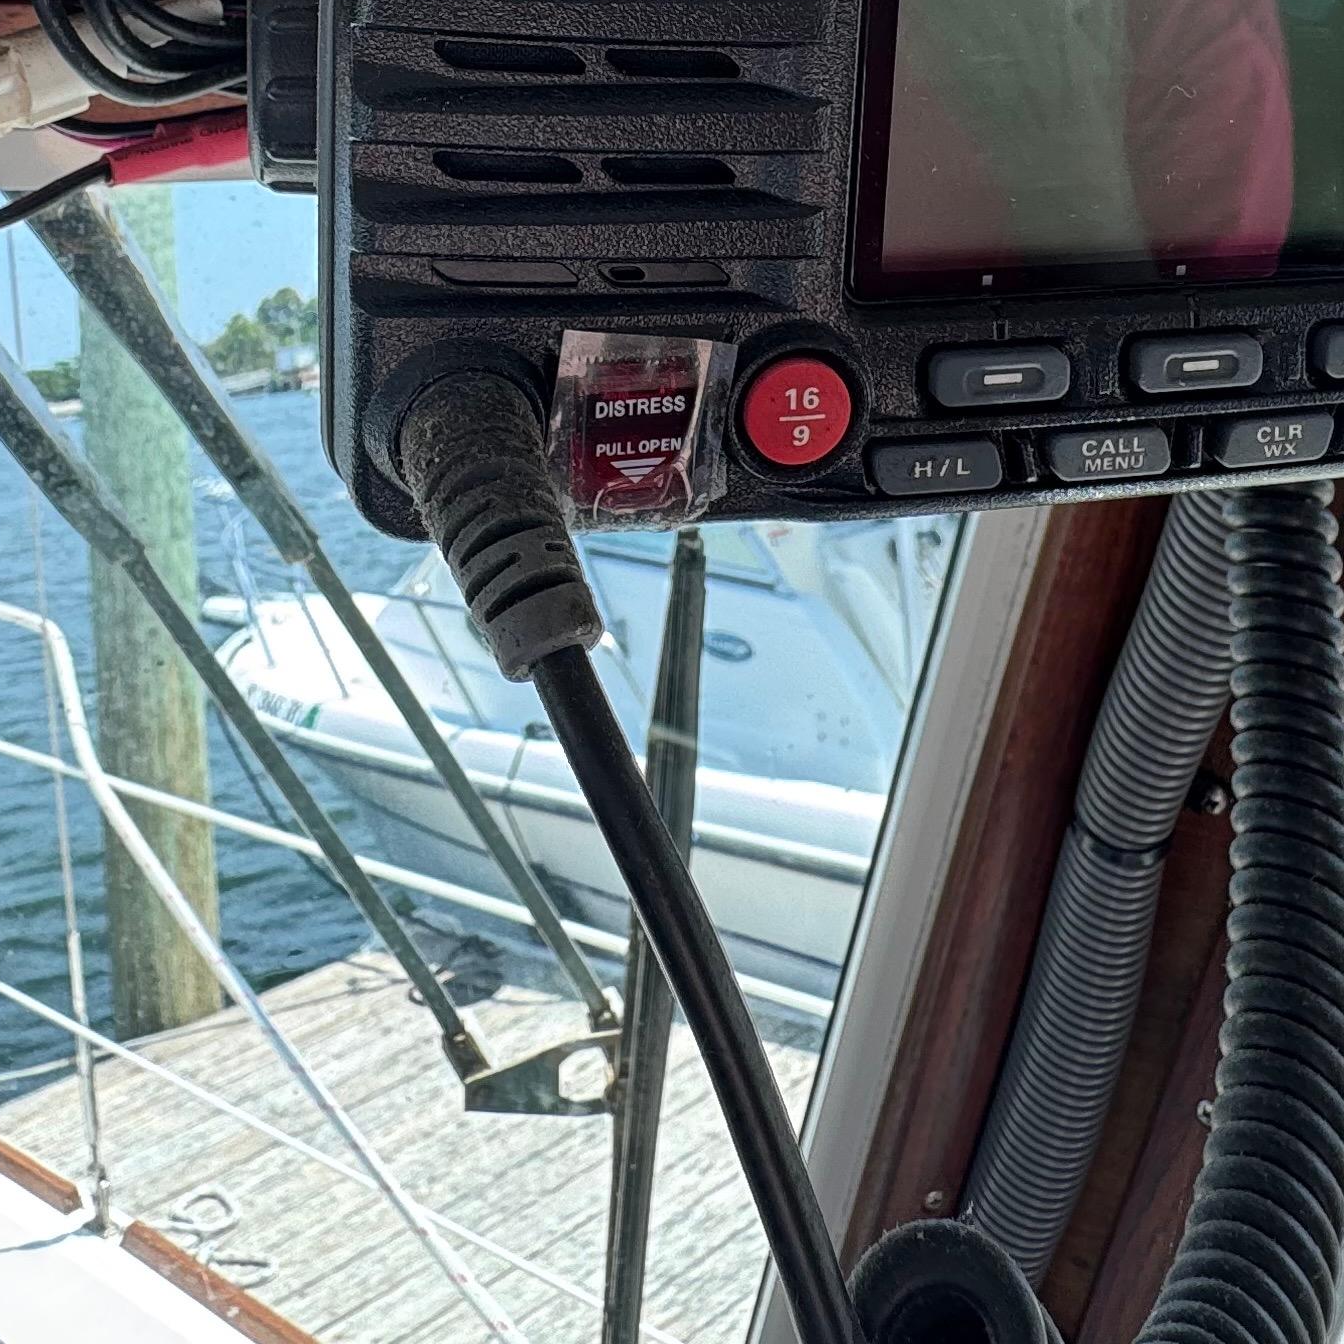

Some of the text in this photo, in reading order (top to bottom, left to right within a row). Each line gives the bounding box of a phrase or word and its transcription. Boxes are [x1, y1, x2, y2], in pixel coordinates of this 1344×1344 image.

[594, 394, 687, 420] DISTRESS
[785, 387, 821, 411] 16
[792, 425, 811, 447] 9
[1256, 424, 1304, 444] CLR
[595, 437, 683, 458] PULL OPEN
[1081, 436, 1146, 457] CALL
[1263, 441, 1298, 458] WX
[1083, 455, 1145, 474] MENU
